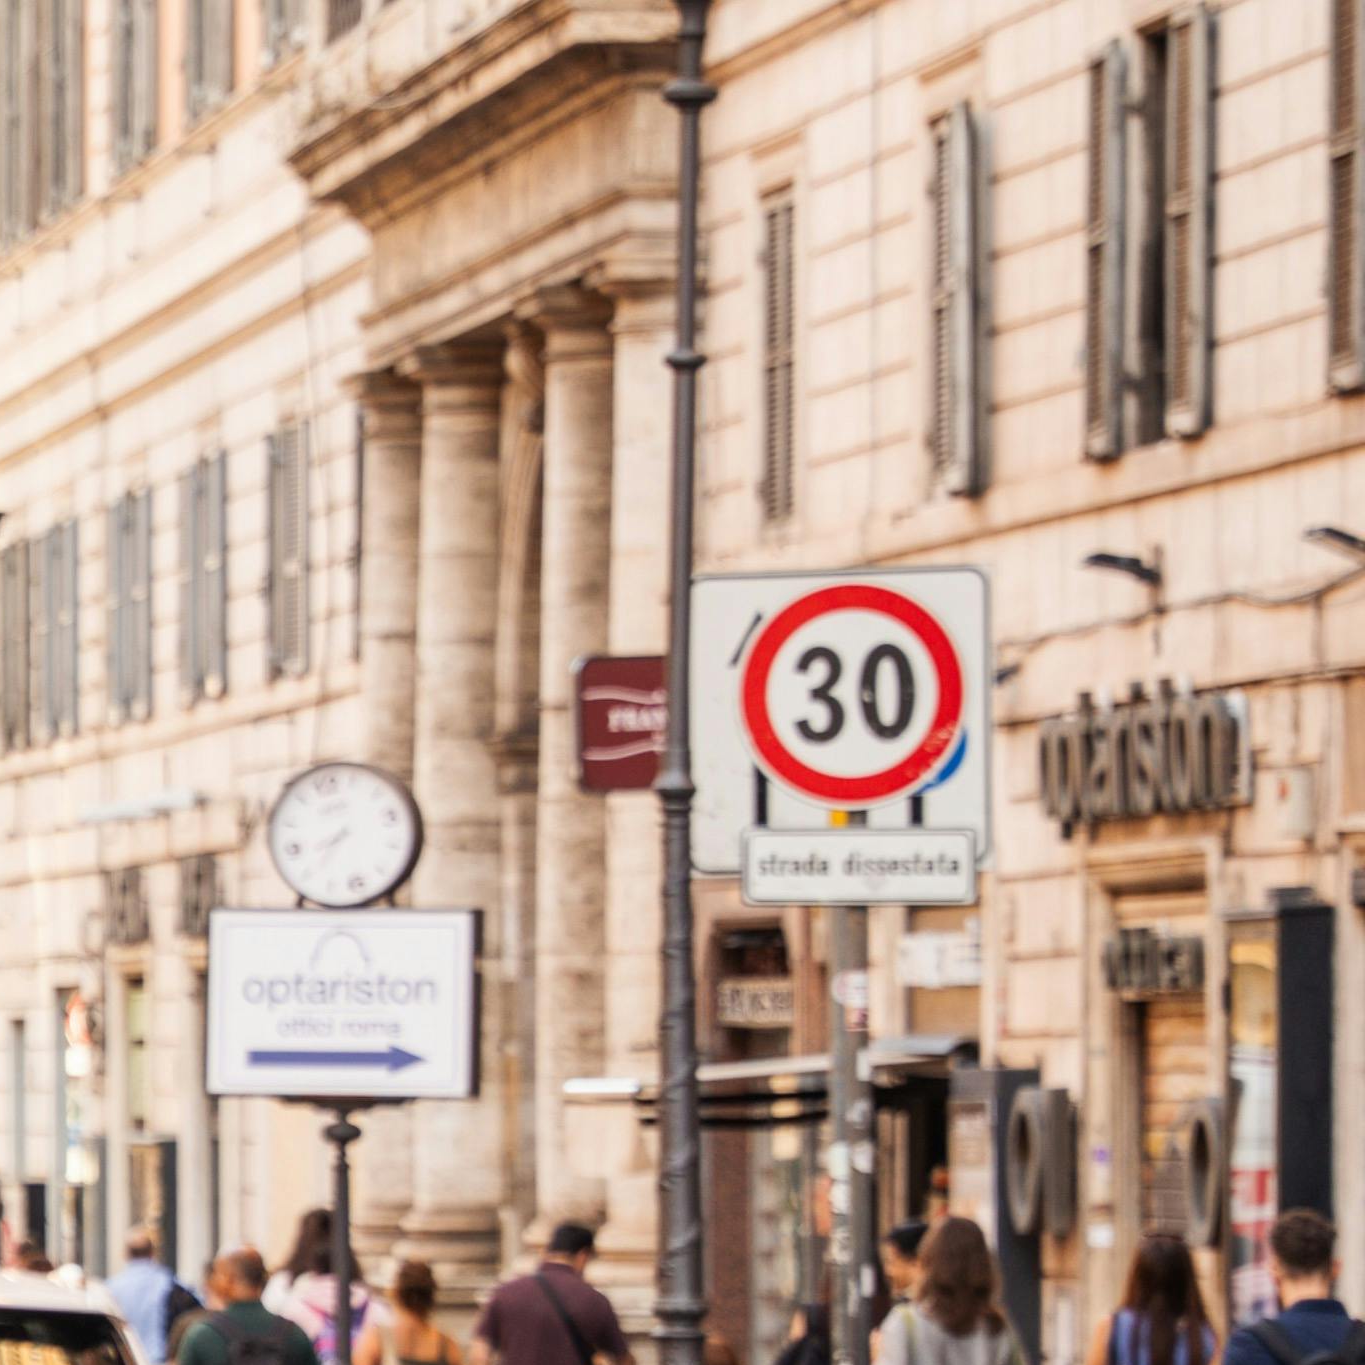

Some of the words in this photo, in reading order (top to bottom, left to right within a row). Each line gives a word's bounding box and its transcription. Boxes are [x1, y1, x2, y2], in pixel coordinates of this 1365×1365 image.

[794, 643, 916, 745] 30
[758, 851, 830, 877] strada
[842, 849, 961, 877] dissestata
[241, 974, 439, 1012] optariston
